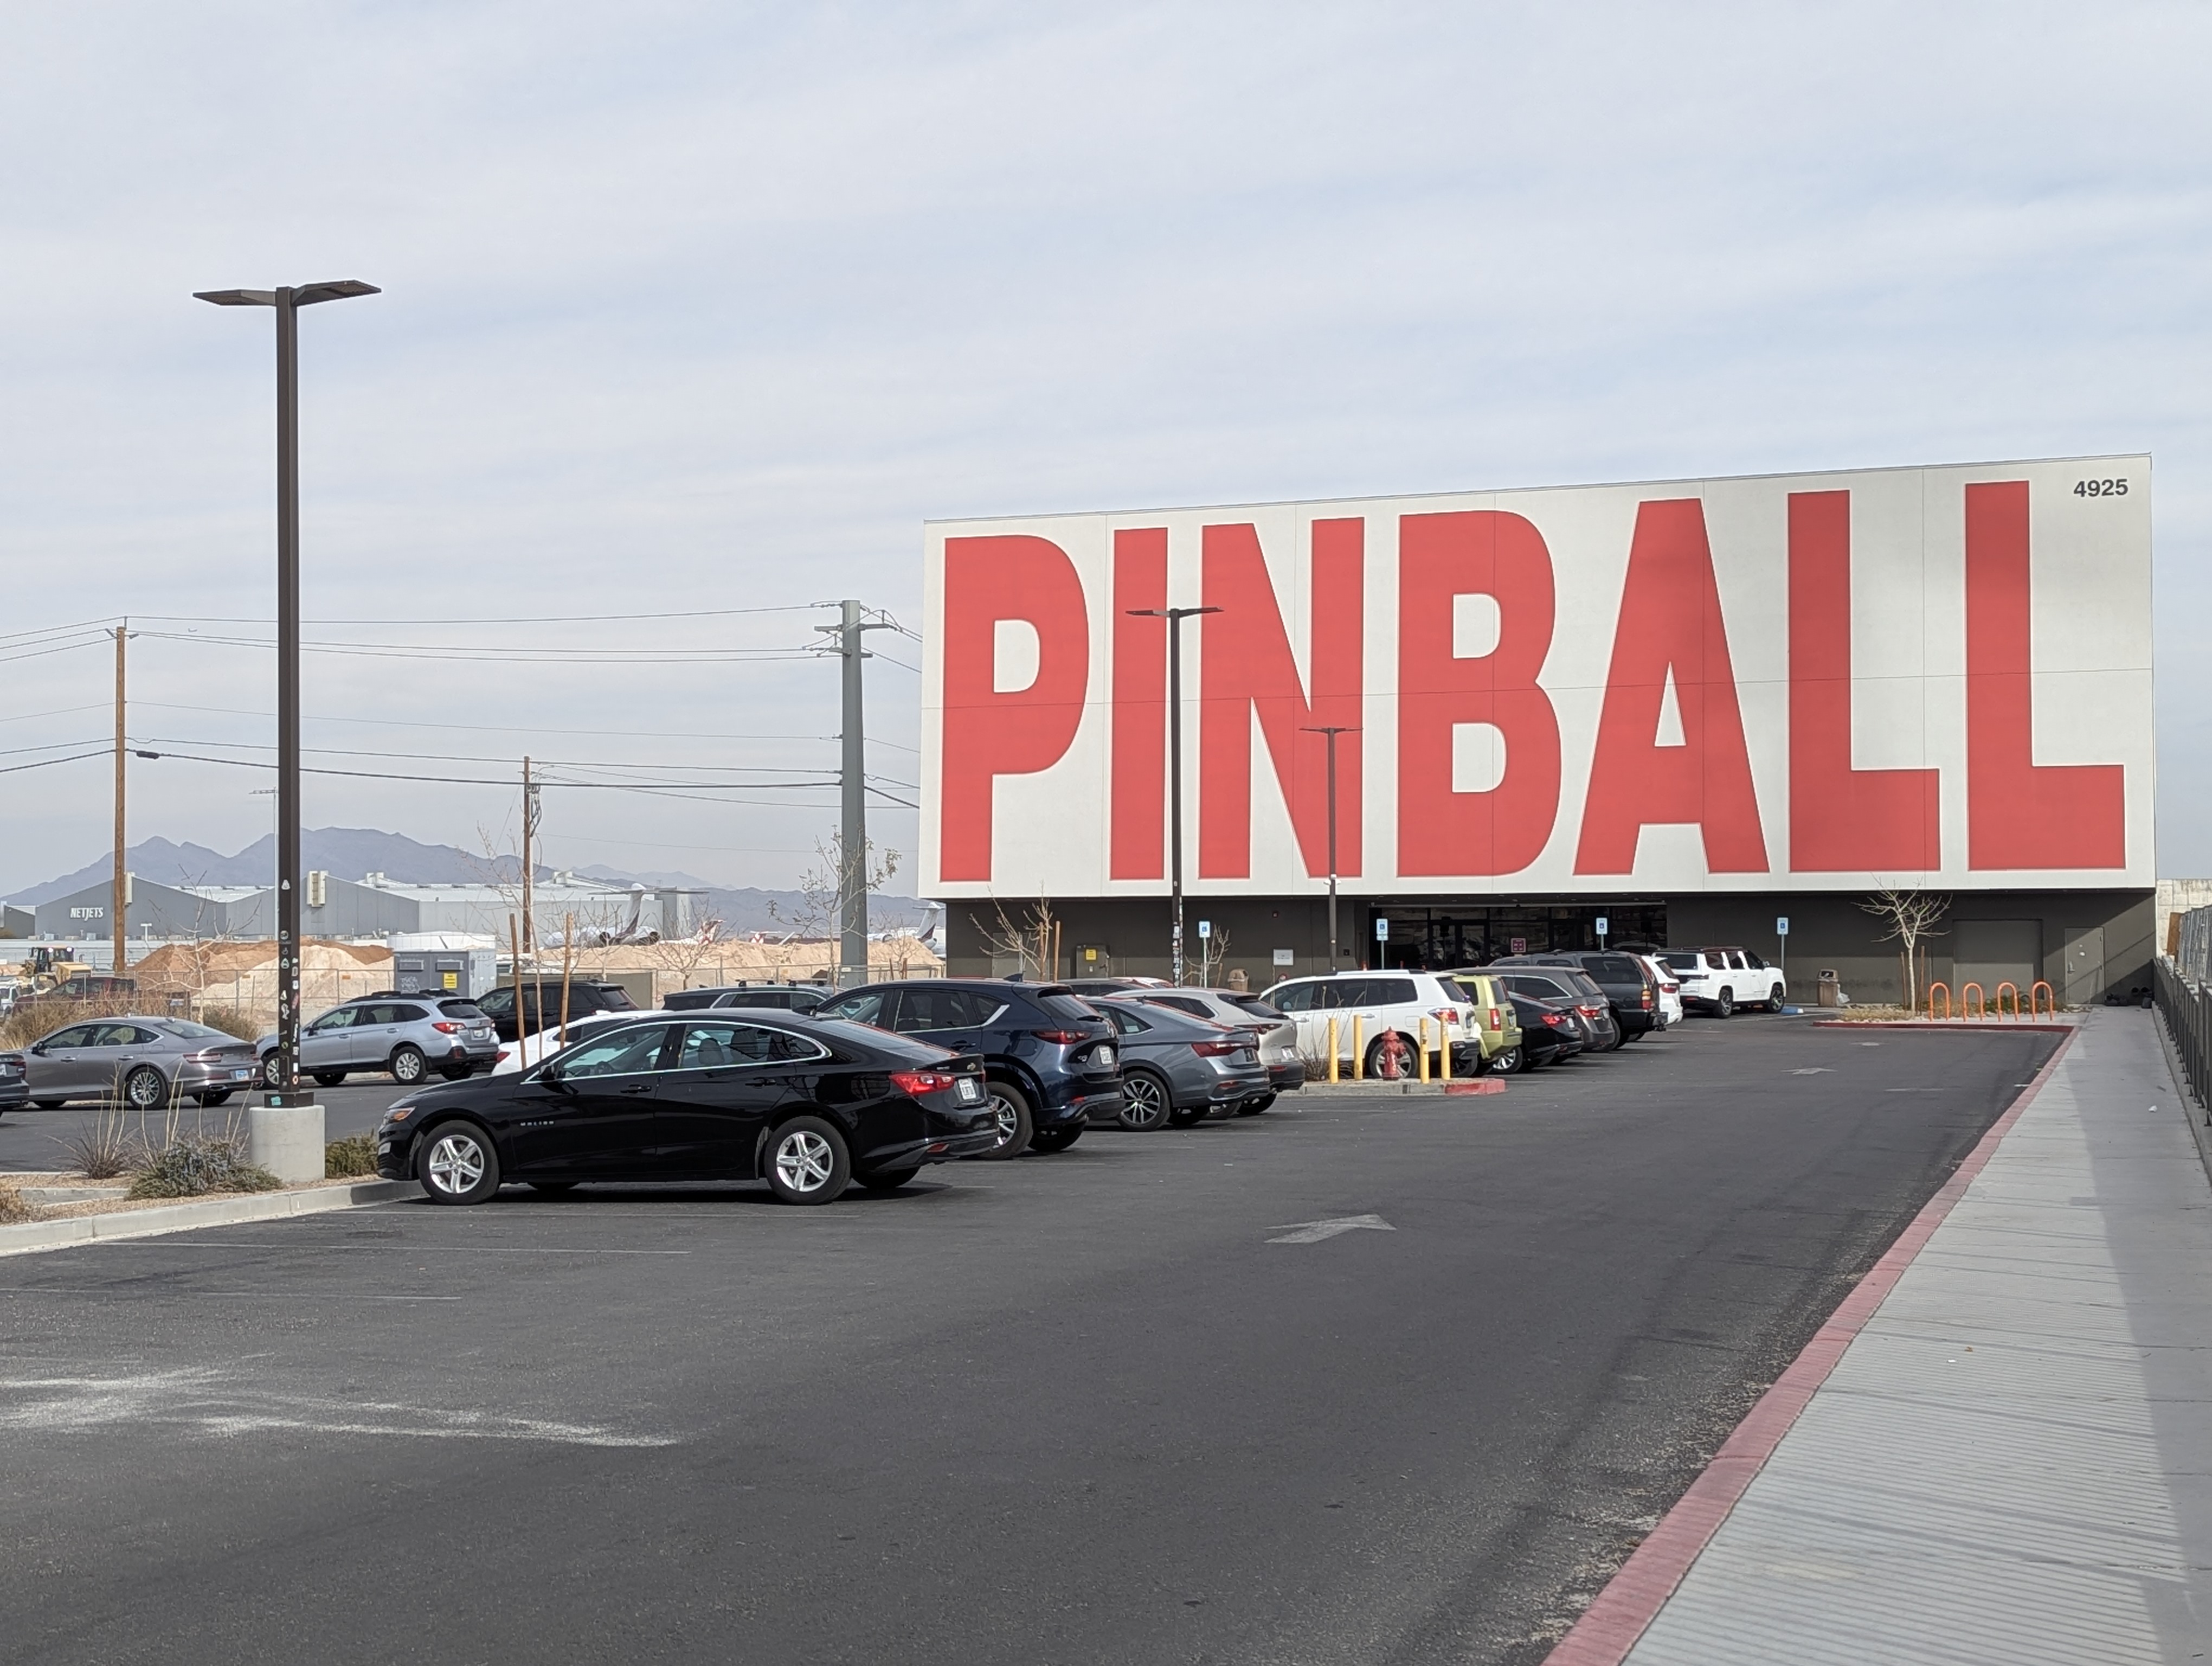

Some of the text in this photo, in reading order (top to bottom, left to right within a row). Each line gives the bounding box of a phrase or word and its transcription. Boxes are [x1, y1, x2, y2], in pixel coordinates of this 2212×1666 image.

[2073, 478, 2129, 497] 4925
[940, 480, 2125, 882] PINBALL
[70, 907, 104, 921] NETJETS
